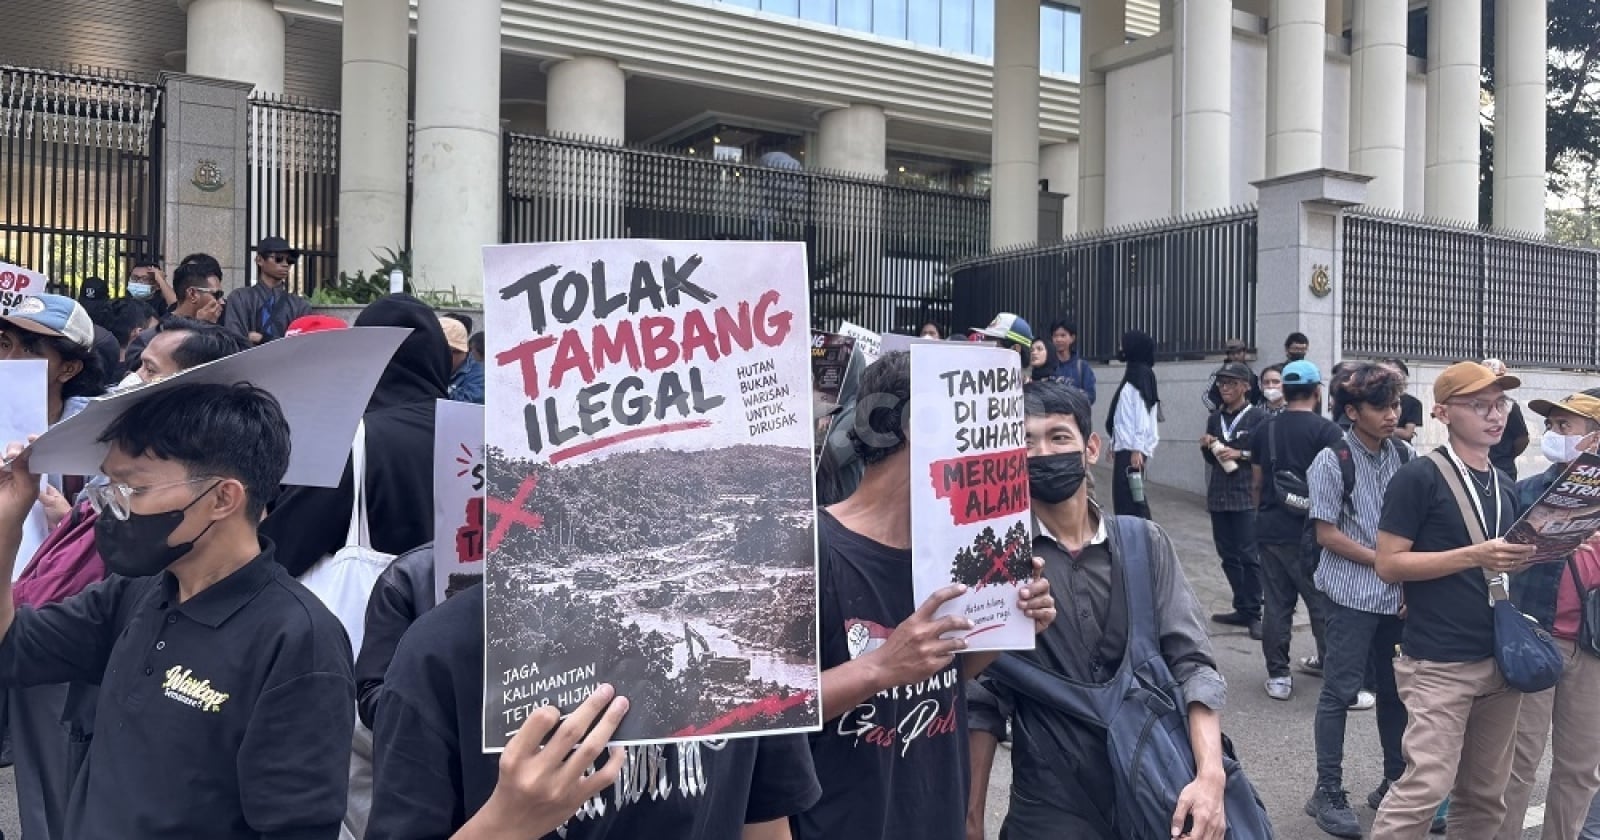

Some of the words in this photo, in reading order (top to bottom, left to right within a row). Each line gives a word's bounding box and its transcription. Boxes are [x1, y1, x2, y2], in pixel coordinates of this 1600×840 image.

[499, 253, 718, 335] TOLAK
[495, 289, 793, 400] TAMBANG
[737, 358, 775, 379] HUTAN
[740, 373, 777, 394] BUKAN
[743, 385, 790, 407] WARISAN
[522, 366, 727, 454] ILEGAL
[746, 402, 785, 422] UNTUK
[954, 400, 977, 424] DI
[749, 412, 797, 437] DIRUSAK
[955, 421, 1025, 453] SUHART
[943, 453, 1027, 492] MERUSA
[965, 483, 1028, 518] ALAM!
[502, 662, 539, 686] JAGA
[503, 662, 596, 705] KALIMANTAN
